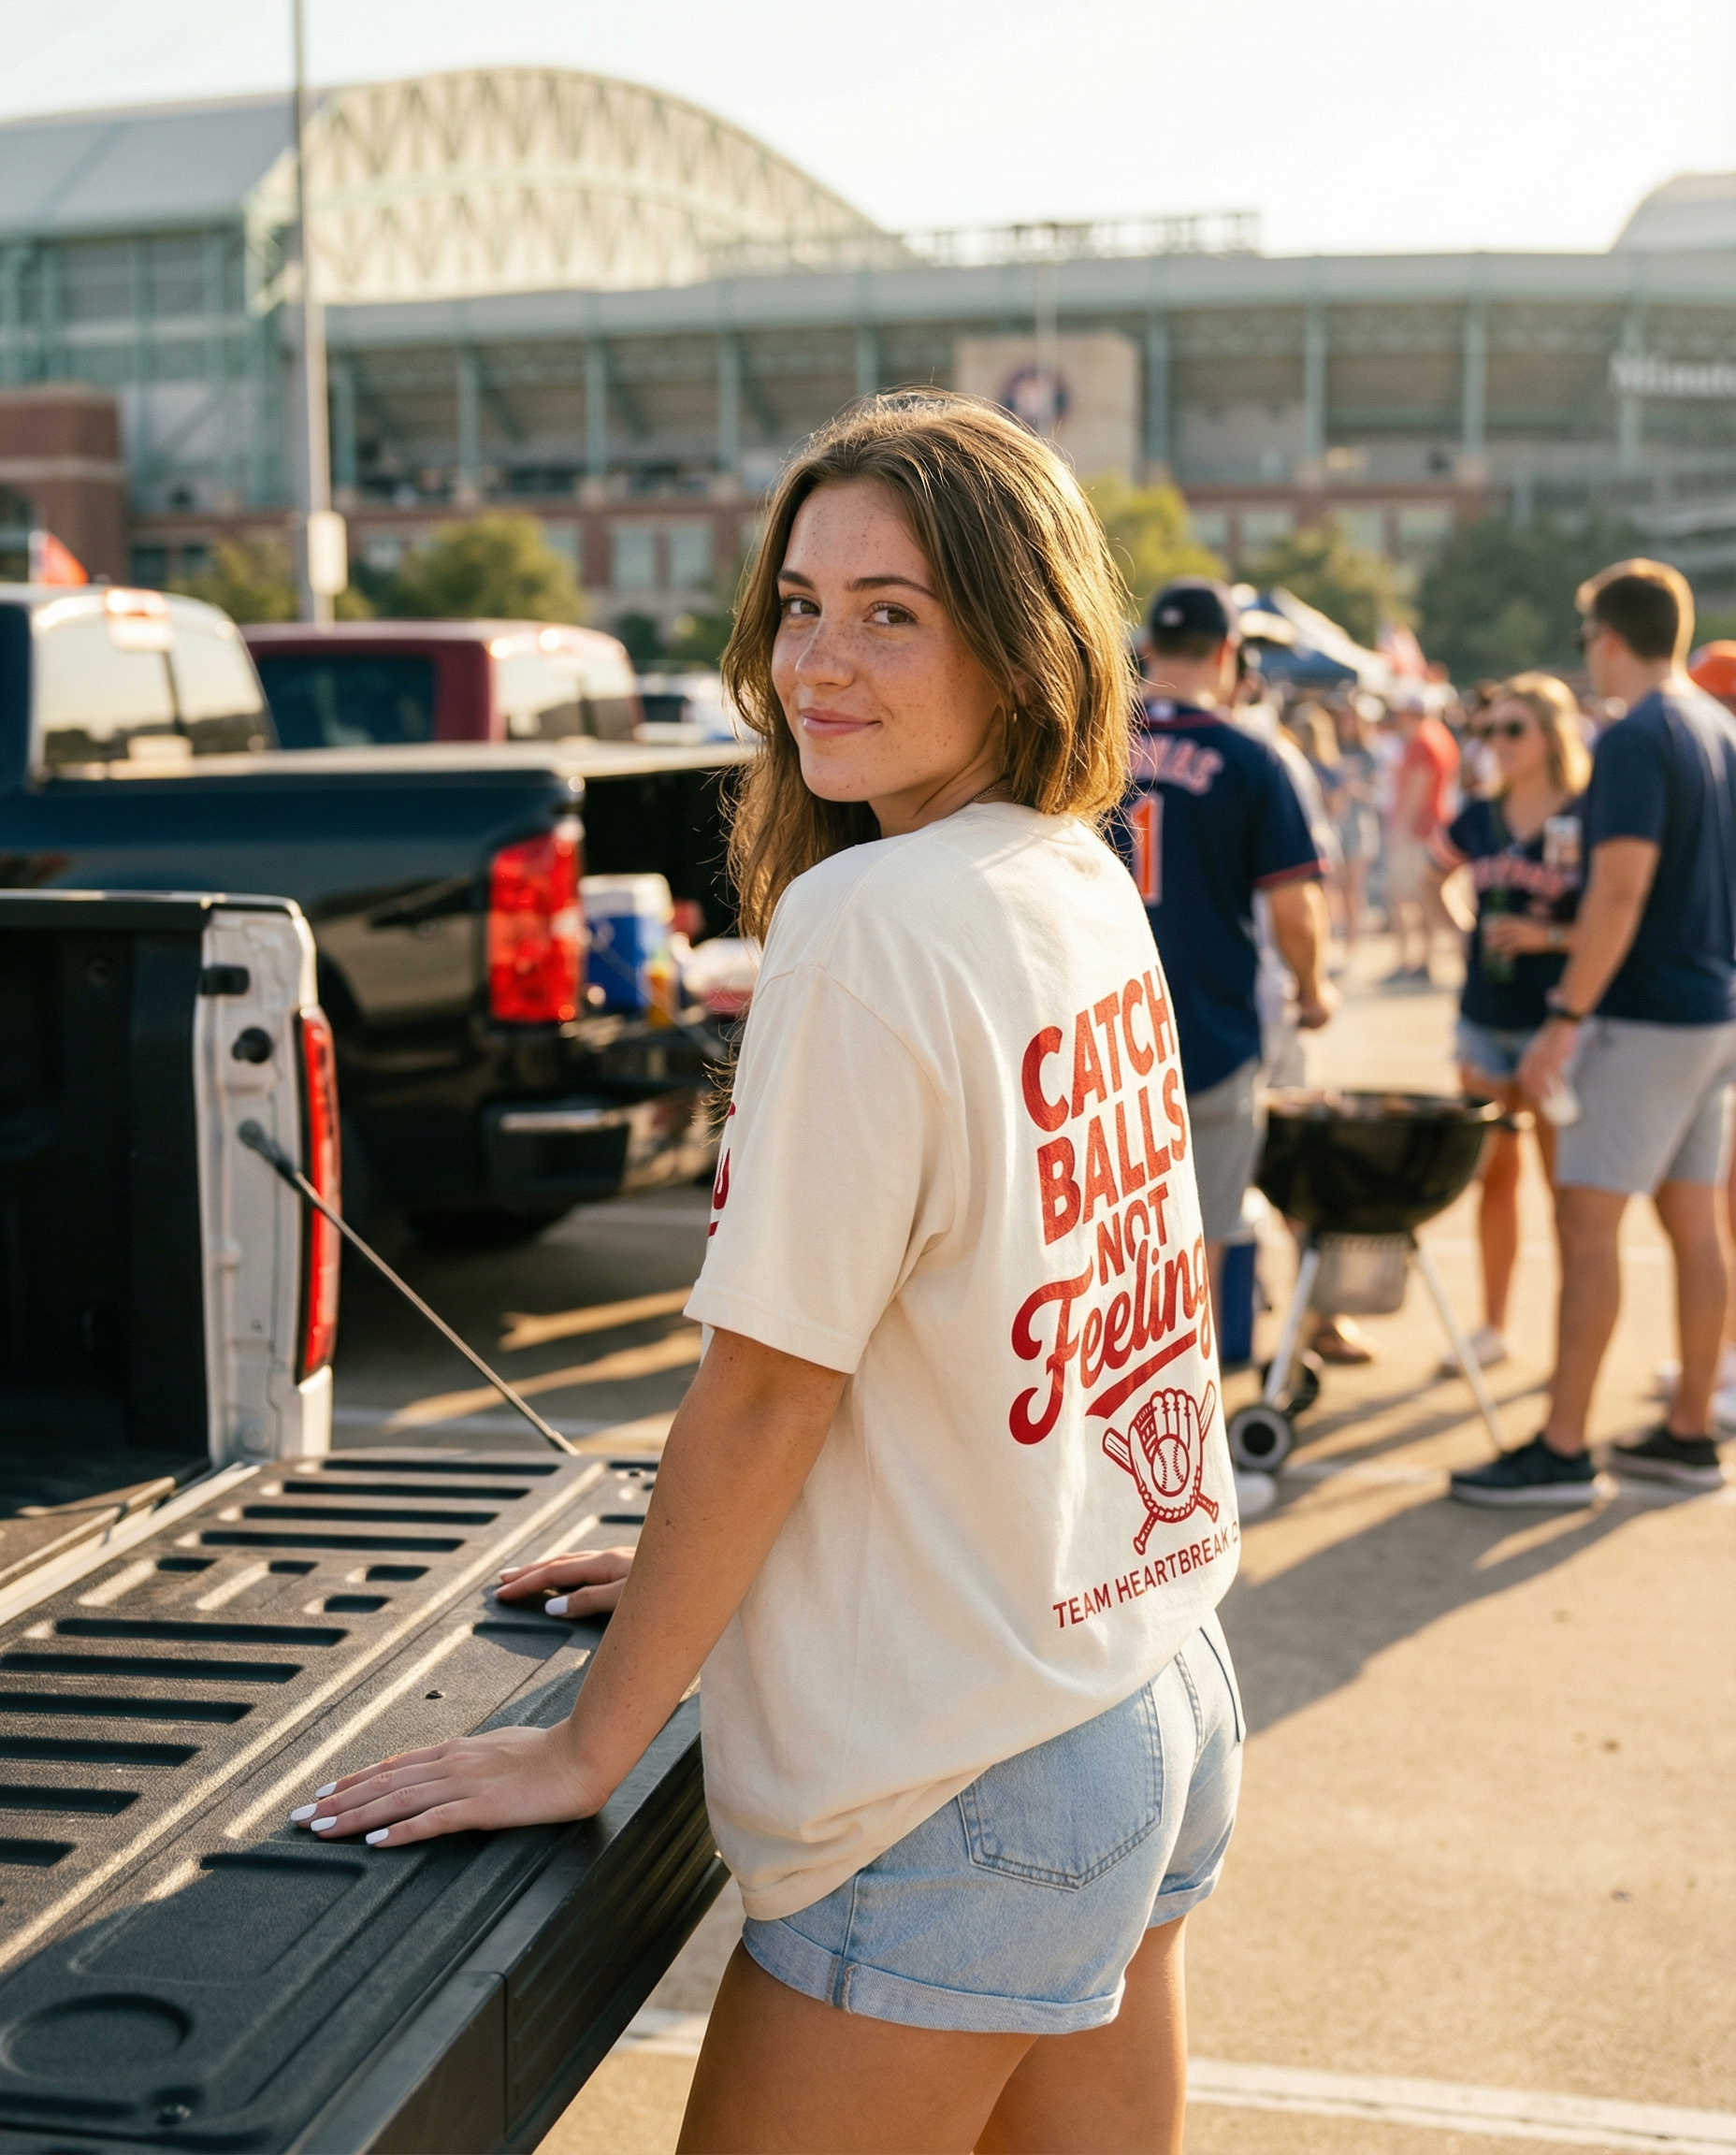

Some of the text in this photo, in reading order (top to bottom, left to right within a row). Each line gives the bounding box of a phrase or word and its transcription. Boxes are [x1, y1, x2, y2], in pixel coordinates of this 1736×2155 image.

[1021, 964, 1176, 1133] CATCH
[1036, 1067, 1187, 1246] BALLS
[1096, 1180, 1169, 1286] NOT
[1052, 1583, 1112, 1628] TEAM
[1115, 1526, 1230, 1603] HEARTBREAK
